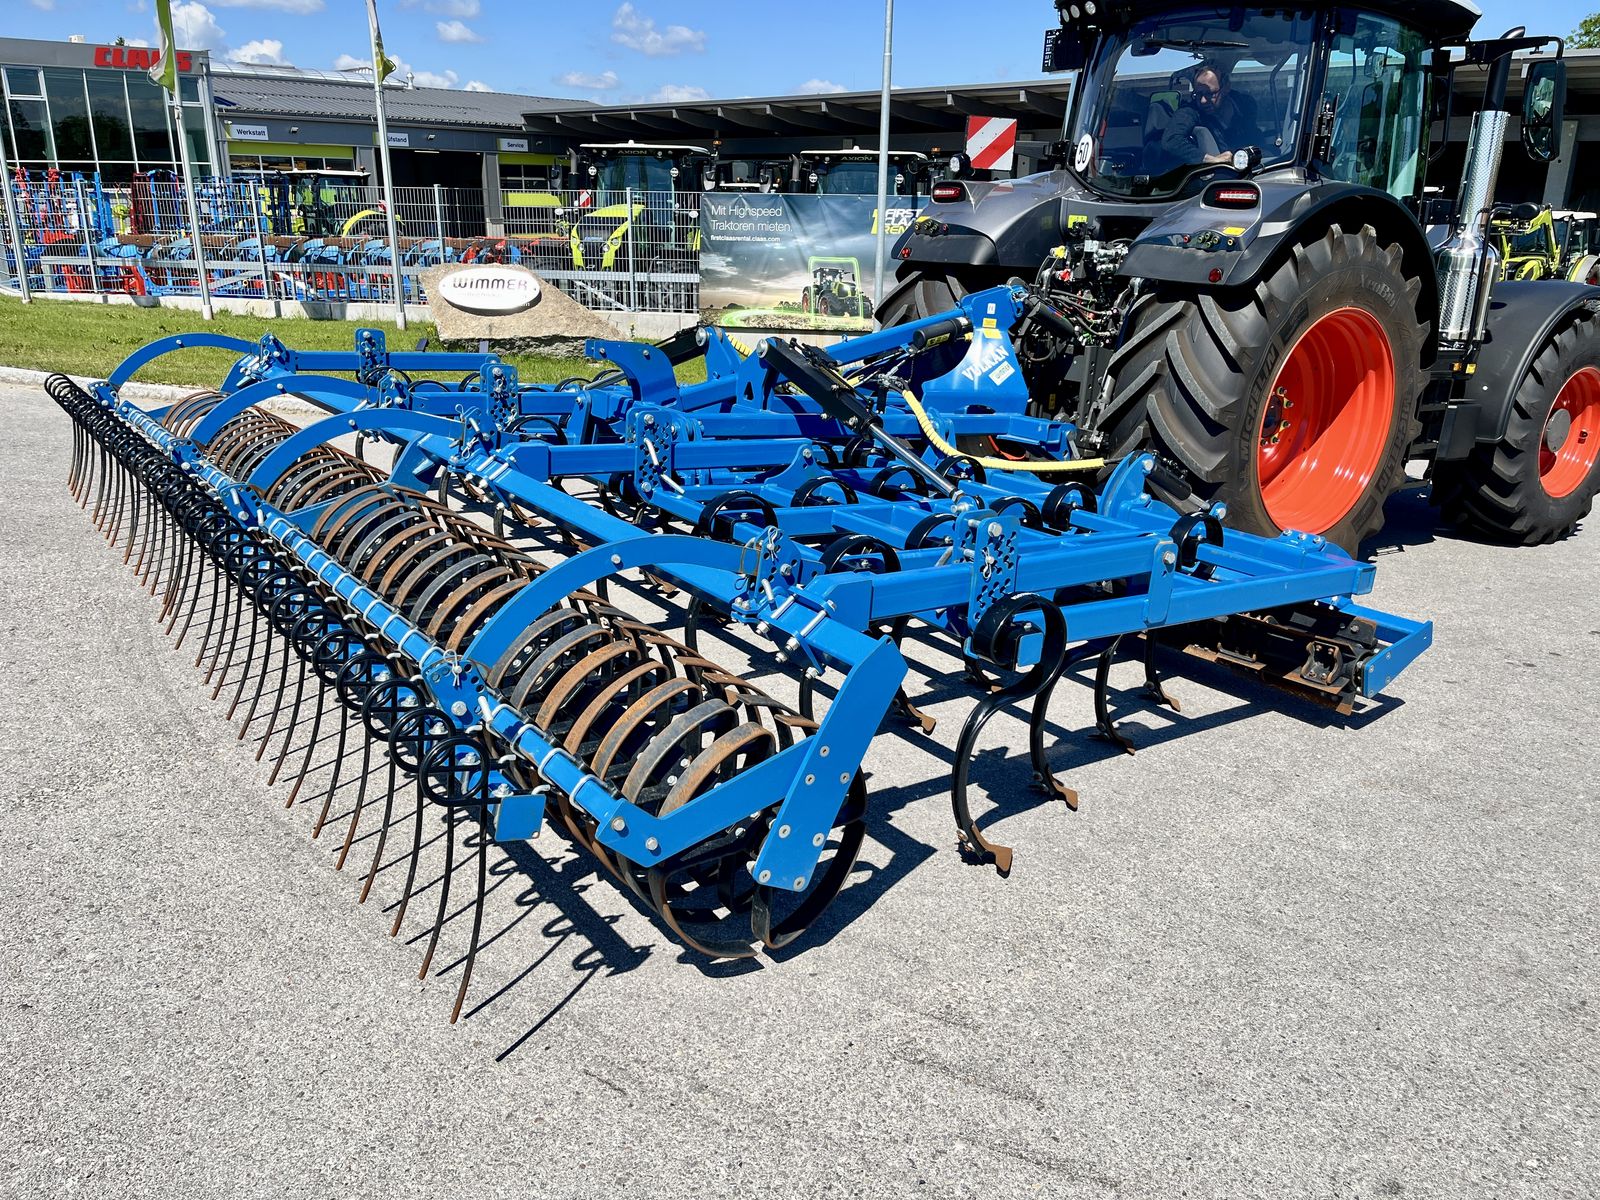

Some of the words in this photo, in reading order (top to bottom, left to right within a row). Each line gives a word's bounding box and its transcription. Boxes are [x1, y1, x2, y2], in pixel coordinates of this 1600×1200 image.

[236, 128, 266, 136] Werkstatt
[506, 141, 525, 149] Service
[1077, 142, 1090, 164] 50
[711, 205, 726, 216] Mit
[728, 205, 782, 218] Highspeed
[885, 208, 923, 218] FIRST
[711, 220, 755, 231] Traktoren
[757, 221, 793, 232] mieten.
[452, 277, 528, 290] WIMMER
[1239, 343, 1279, 460] MICHELIN
